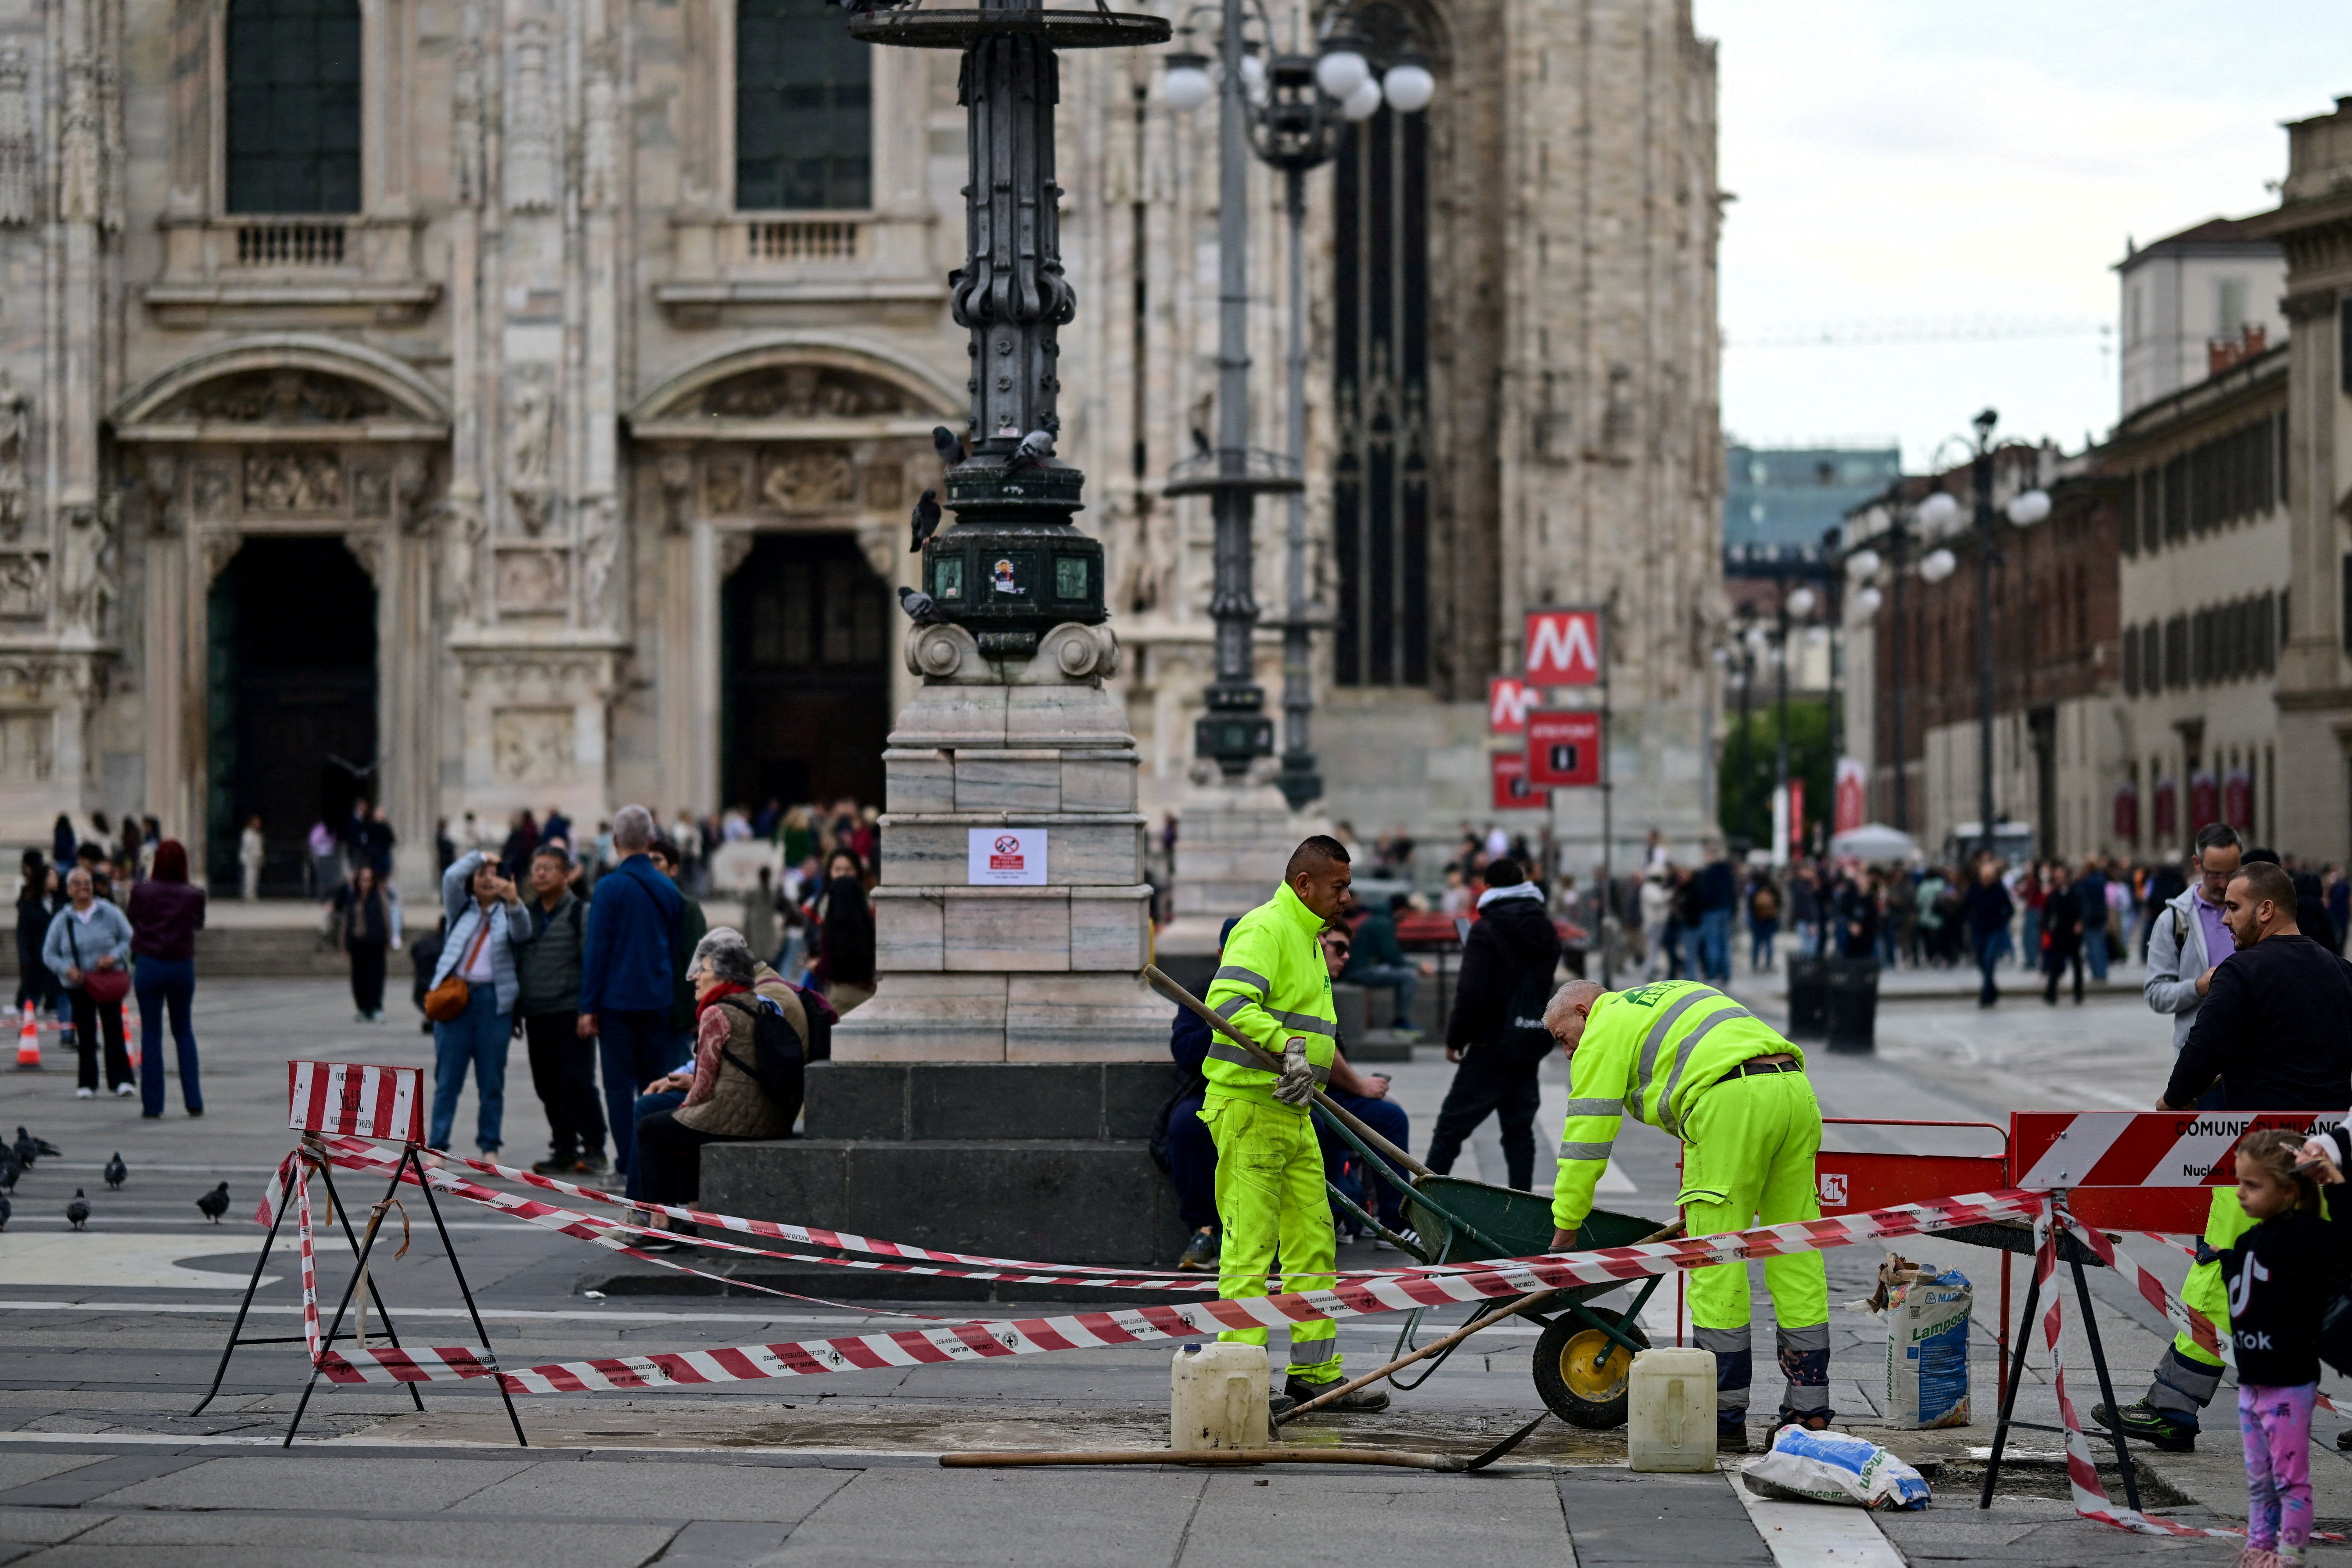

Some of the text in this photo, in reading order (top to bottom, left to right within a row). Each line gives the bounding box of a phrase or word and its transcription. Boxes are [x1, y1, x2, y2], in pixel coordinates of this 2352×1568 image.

[1528, 617, 1597, 671] M
[2176, 1121, 2249, 1137] COMUNE
[2183, 1164, 2225, 1177] Nucleo
[1310, 1295, 1338, 1305] INTERVENTO
[1330, 1303, 1351, 1312] COMUNE
[2163, 1302, 2181, 1317] MILANO
[1126, 1327, 1145, 1335] MILANO
[1149, 1324, 1170, 1333] COMUNE
